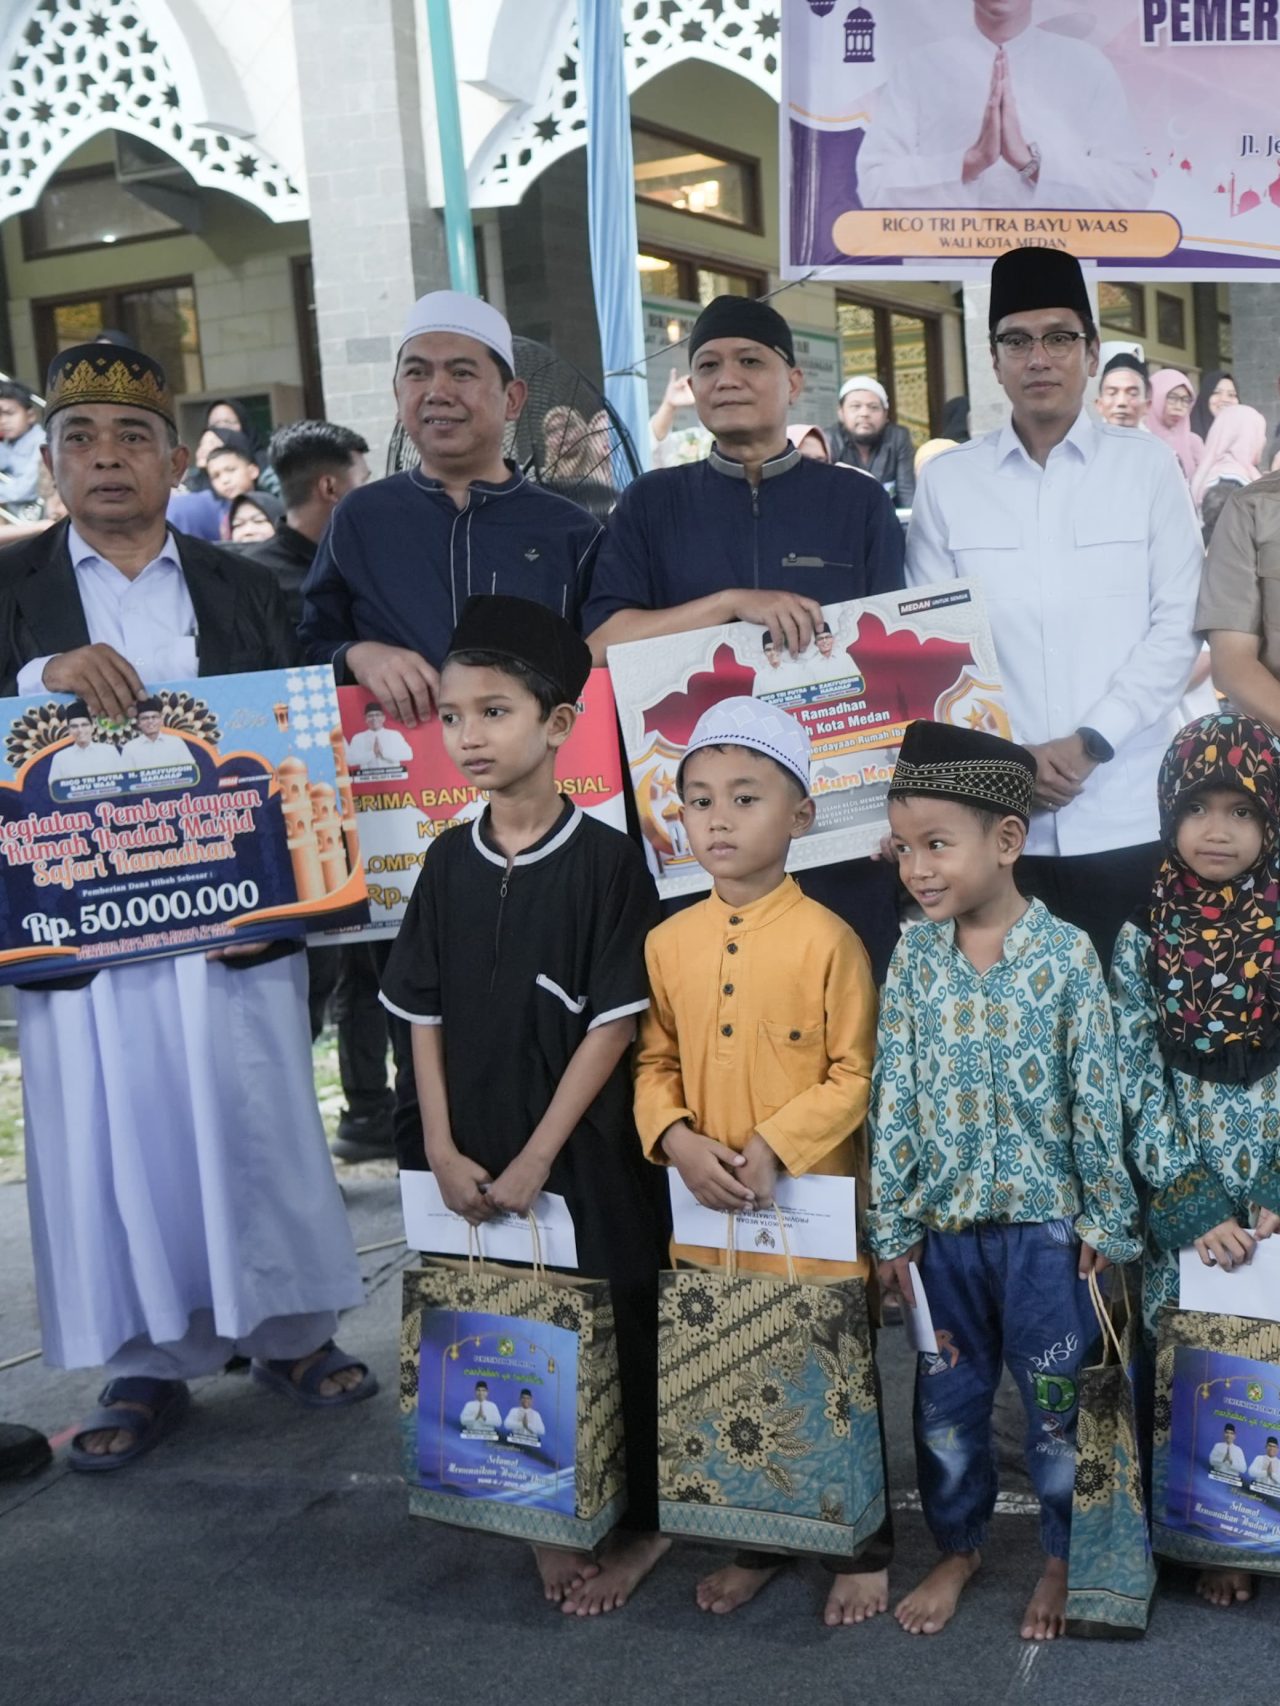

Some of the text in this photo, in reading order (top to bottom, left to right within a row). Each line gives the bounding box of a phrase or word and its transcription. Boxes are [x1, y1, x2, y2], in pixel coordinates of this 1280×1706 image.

[1240, 134, 1259, 157] Jl.
[882, 217, 1129, 233] RICO TRI PUTRA BAYU WAAS
[939, 236, 1067, 249] WALI KOTA MEDAN
[901, 599, 931, 613] MEDAN
[801, 699, 867, 722] Ramadhan
[816, 718, 845, 735] Kota
[847, 710, 890, 728] Medan
[857, 732, 890, 746] Rumah
[95, 789, 262, 826] Pemberdayaan
[1, 809, 255, 866] Rumah Ibadah Masjid
[33, 839, 236, 889] Safari Ramadhan
[82, 884, 127, 897] Pemberian
[128, 881, 149, 892] Dana
[151, 876, 176, 889] Hibah
[177, 872, 208, 884] Sebesar
[22, 912, 76, 947] Rp.
[80, 879, 259, 935] 50.000.000
[1030, 1331, 1078, 1372] BASE
